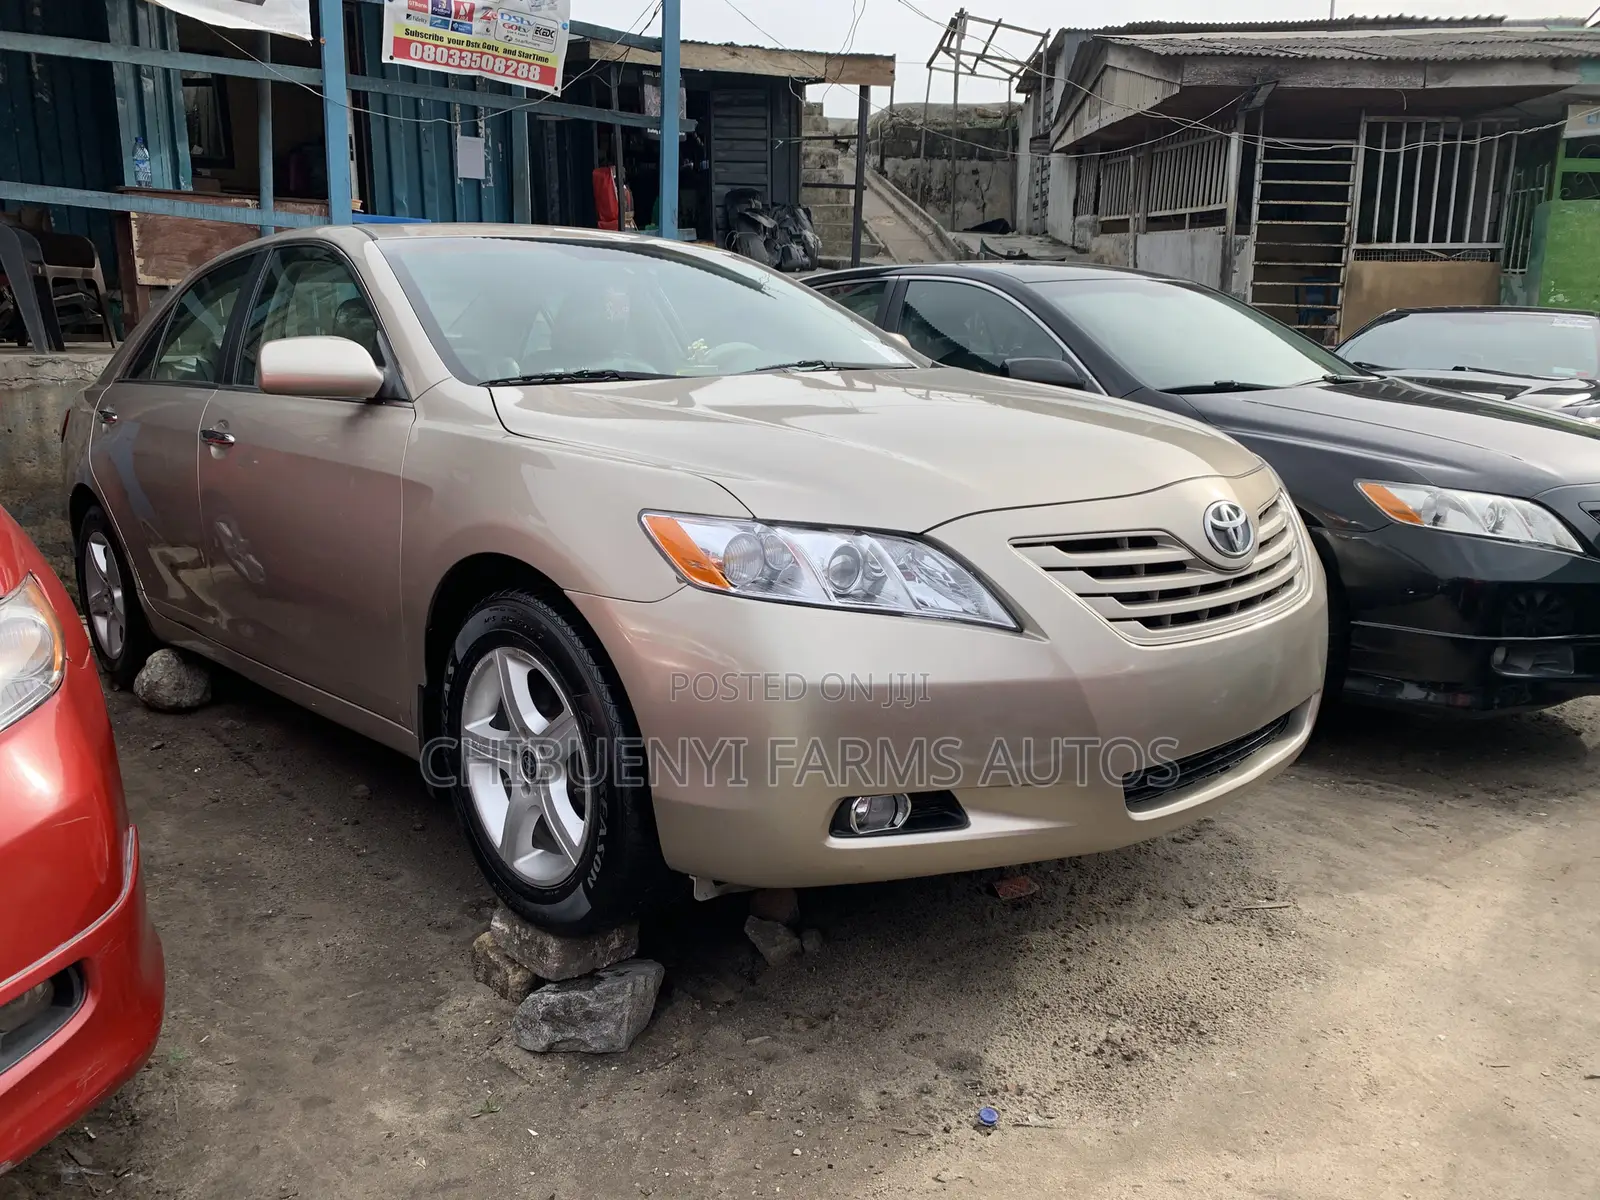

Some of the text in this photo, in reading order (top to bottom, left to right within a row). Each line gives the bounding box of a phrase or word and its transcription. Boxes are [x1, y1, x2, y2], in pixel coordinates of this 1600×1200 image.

[404, 28, 445, 43] Subscribe
[447, 37, 465, 47] your
[503, 47, 517, 57] and
[518, 50, 549, 64] StarTime
[409, 41, 541, 81] 08033508288
